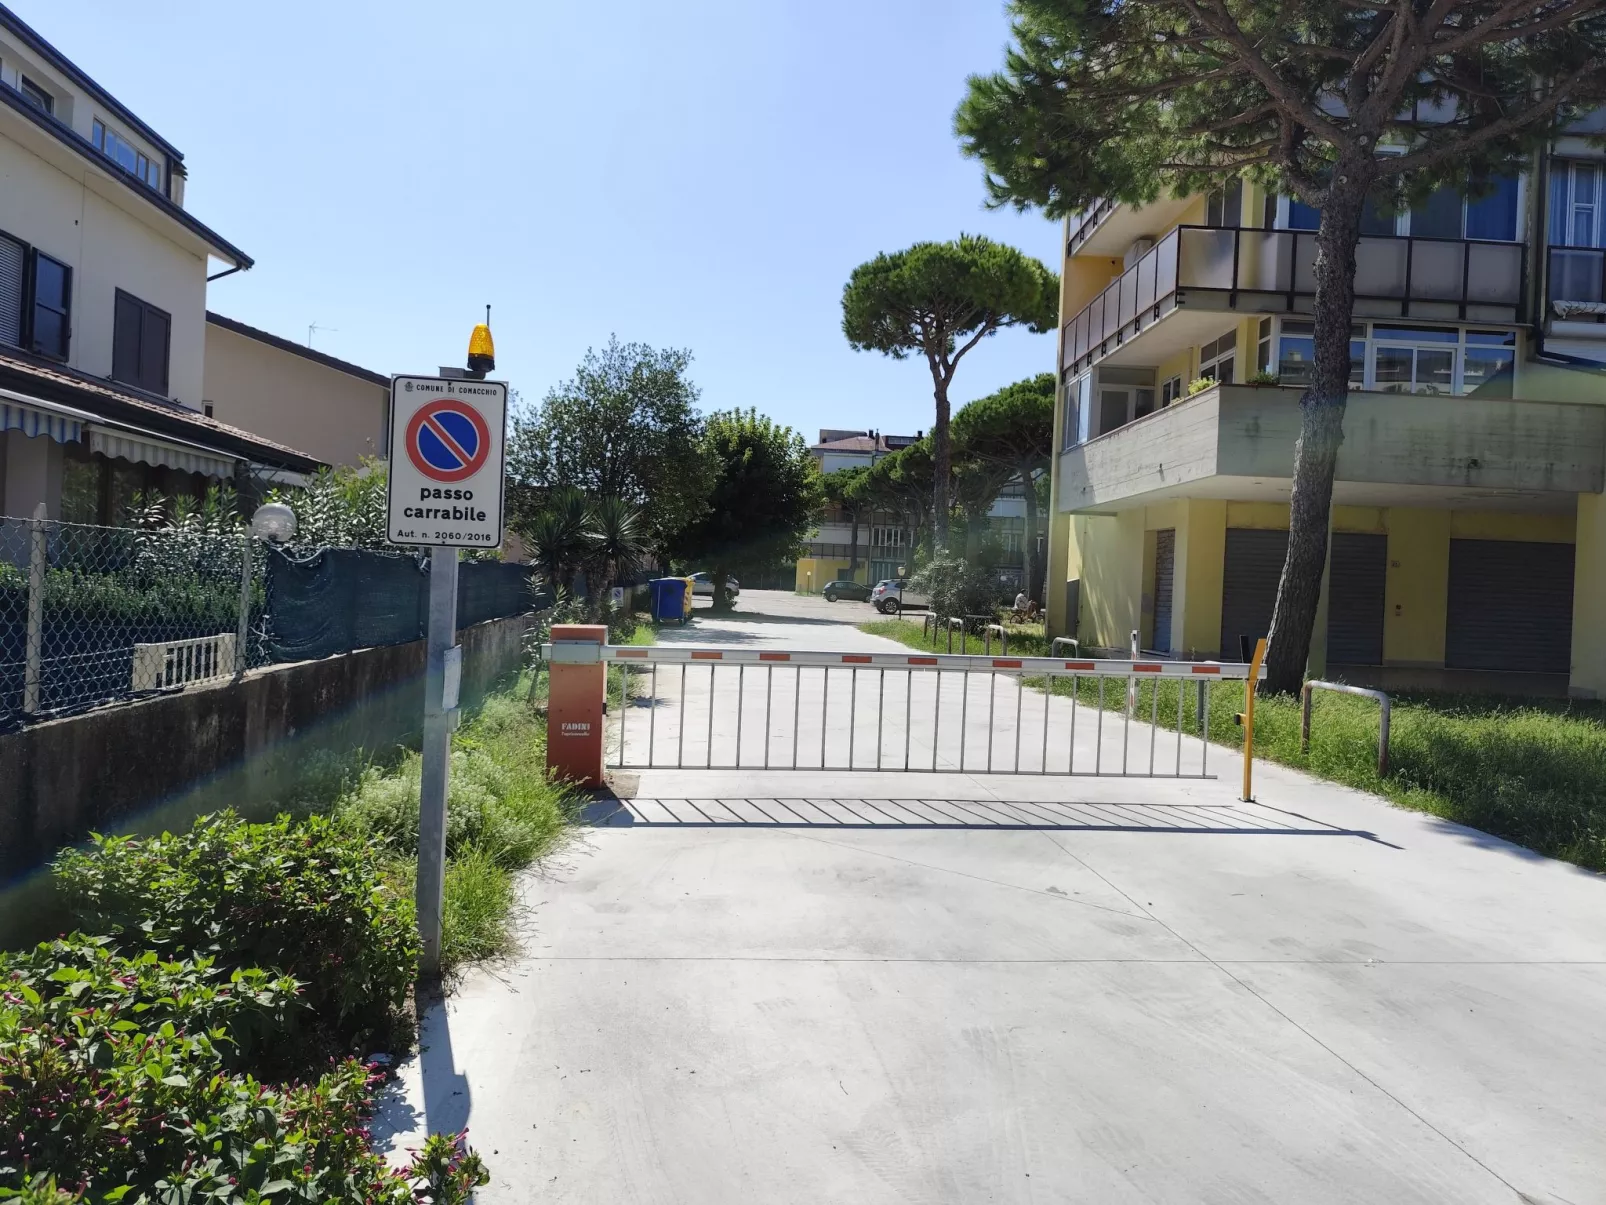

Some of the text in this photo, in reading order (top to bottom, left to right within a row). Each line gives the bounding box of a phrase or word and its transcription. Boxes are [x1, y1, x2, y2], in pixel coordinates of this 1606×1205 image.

[416, 384, 444, 393] COMUNE
[458, 387, 497, 396] COMACCHIO
[420, 487, 474, 501] passo
[403, 506, 487, 522] carrabile
[397, 529, 418, 538] Aut.
[434, 531, 492, 542] 2060/2016
